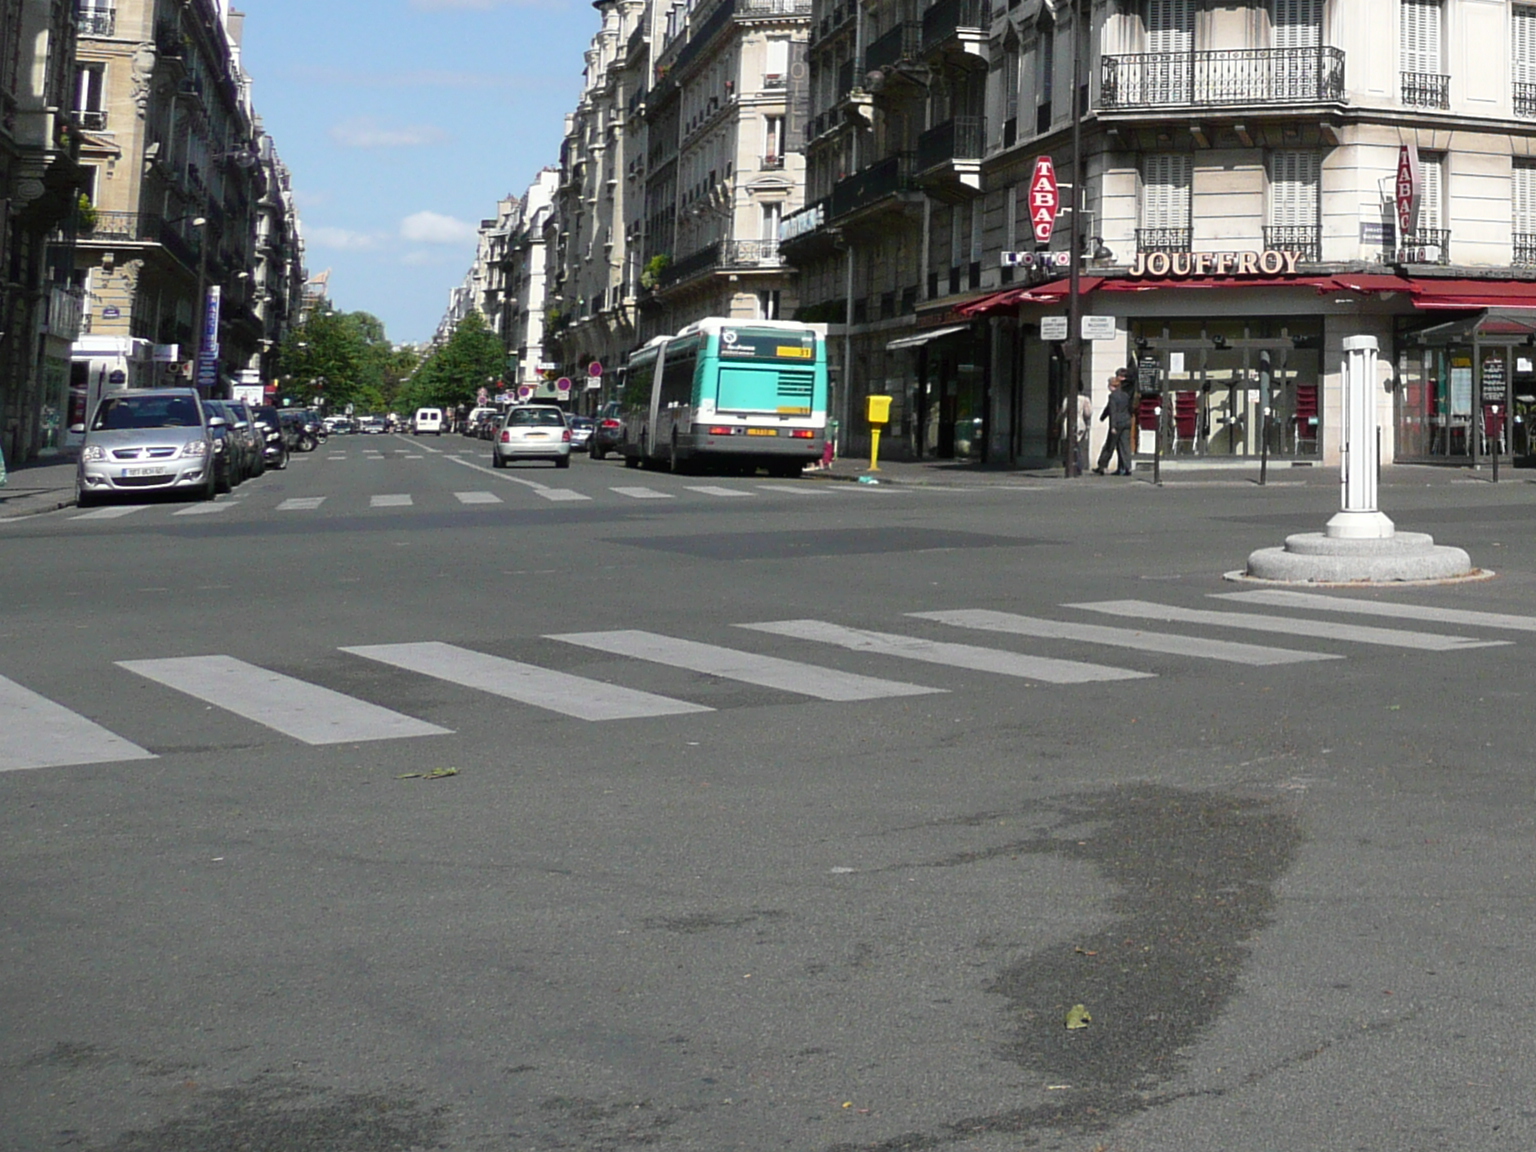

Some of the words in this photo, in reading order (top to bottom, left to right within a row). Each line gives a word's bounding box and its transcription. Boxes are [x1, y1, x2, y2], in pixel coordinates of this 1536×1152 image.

[790, 44, 806, 133] HOTEL
[1032, 161, 1055, 238] TABAC
[1398, 151, 1411, 229] TABAC
[1128, 250, 1301, 275] JOUFFROY
